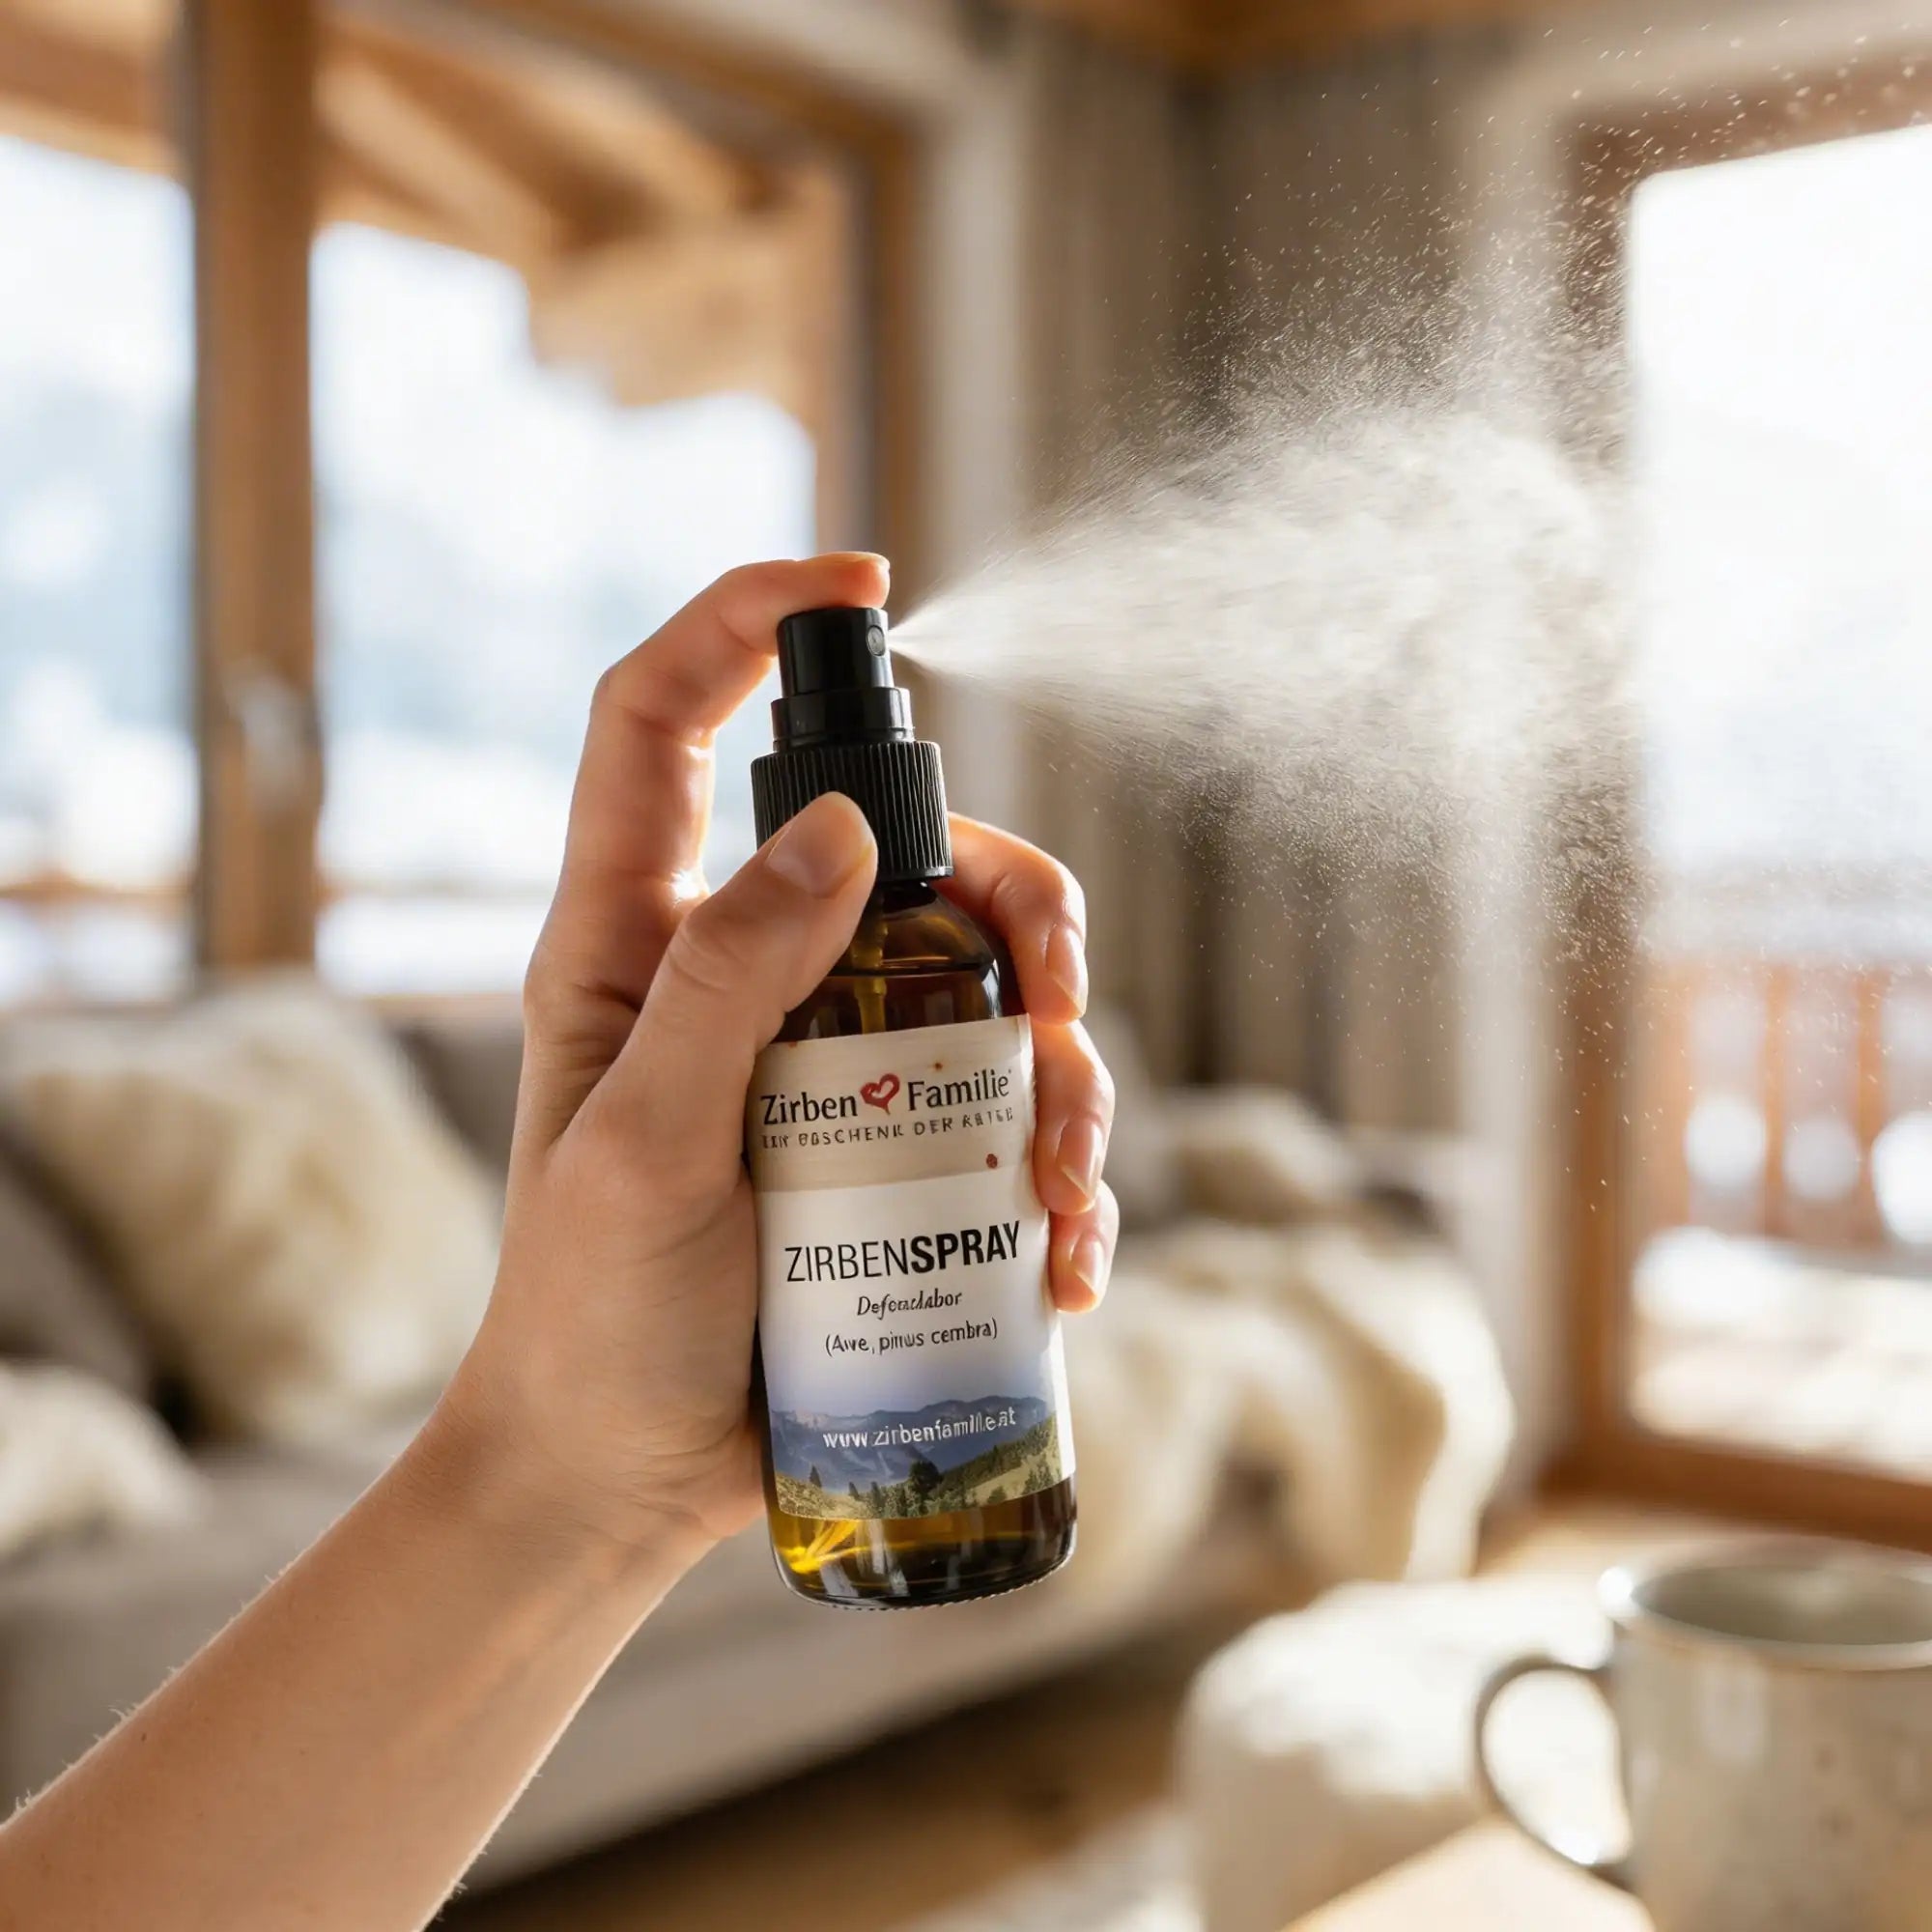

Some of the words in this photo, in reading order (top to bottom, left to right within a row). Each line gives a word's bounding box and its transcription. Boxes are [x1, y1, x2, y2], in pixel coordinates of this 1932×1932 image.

[760, 1092, 858, 1125] Zirben
[907, 1068, 1010, 1111] Familie
[784, 1220, 1020, 1283] ZIRBENSPRAY
[931, 1318, 999, 1346] cembra)
